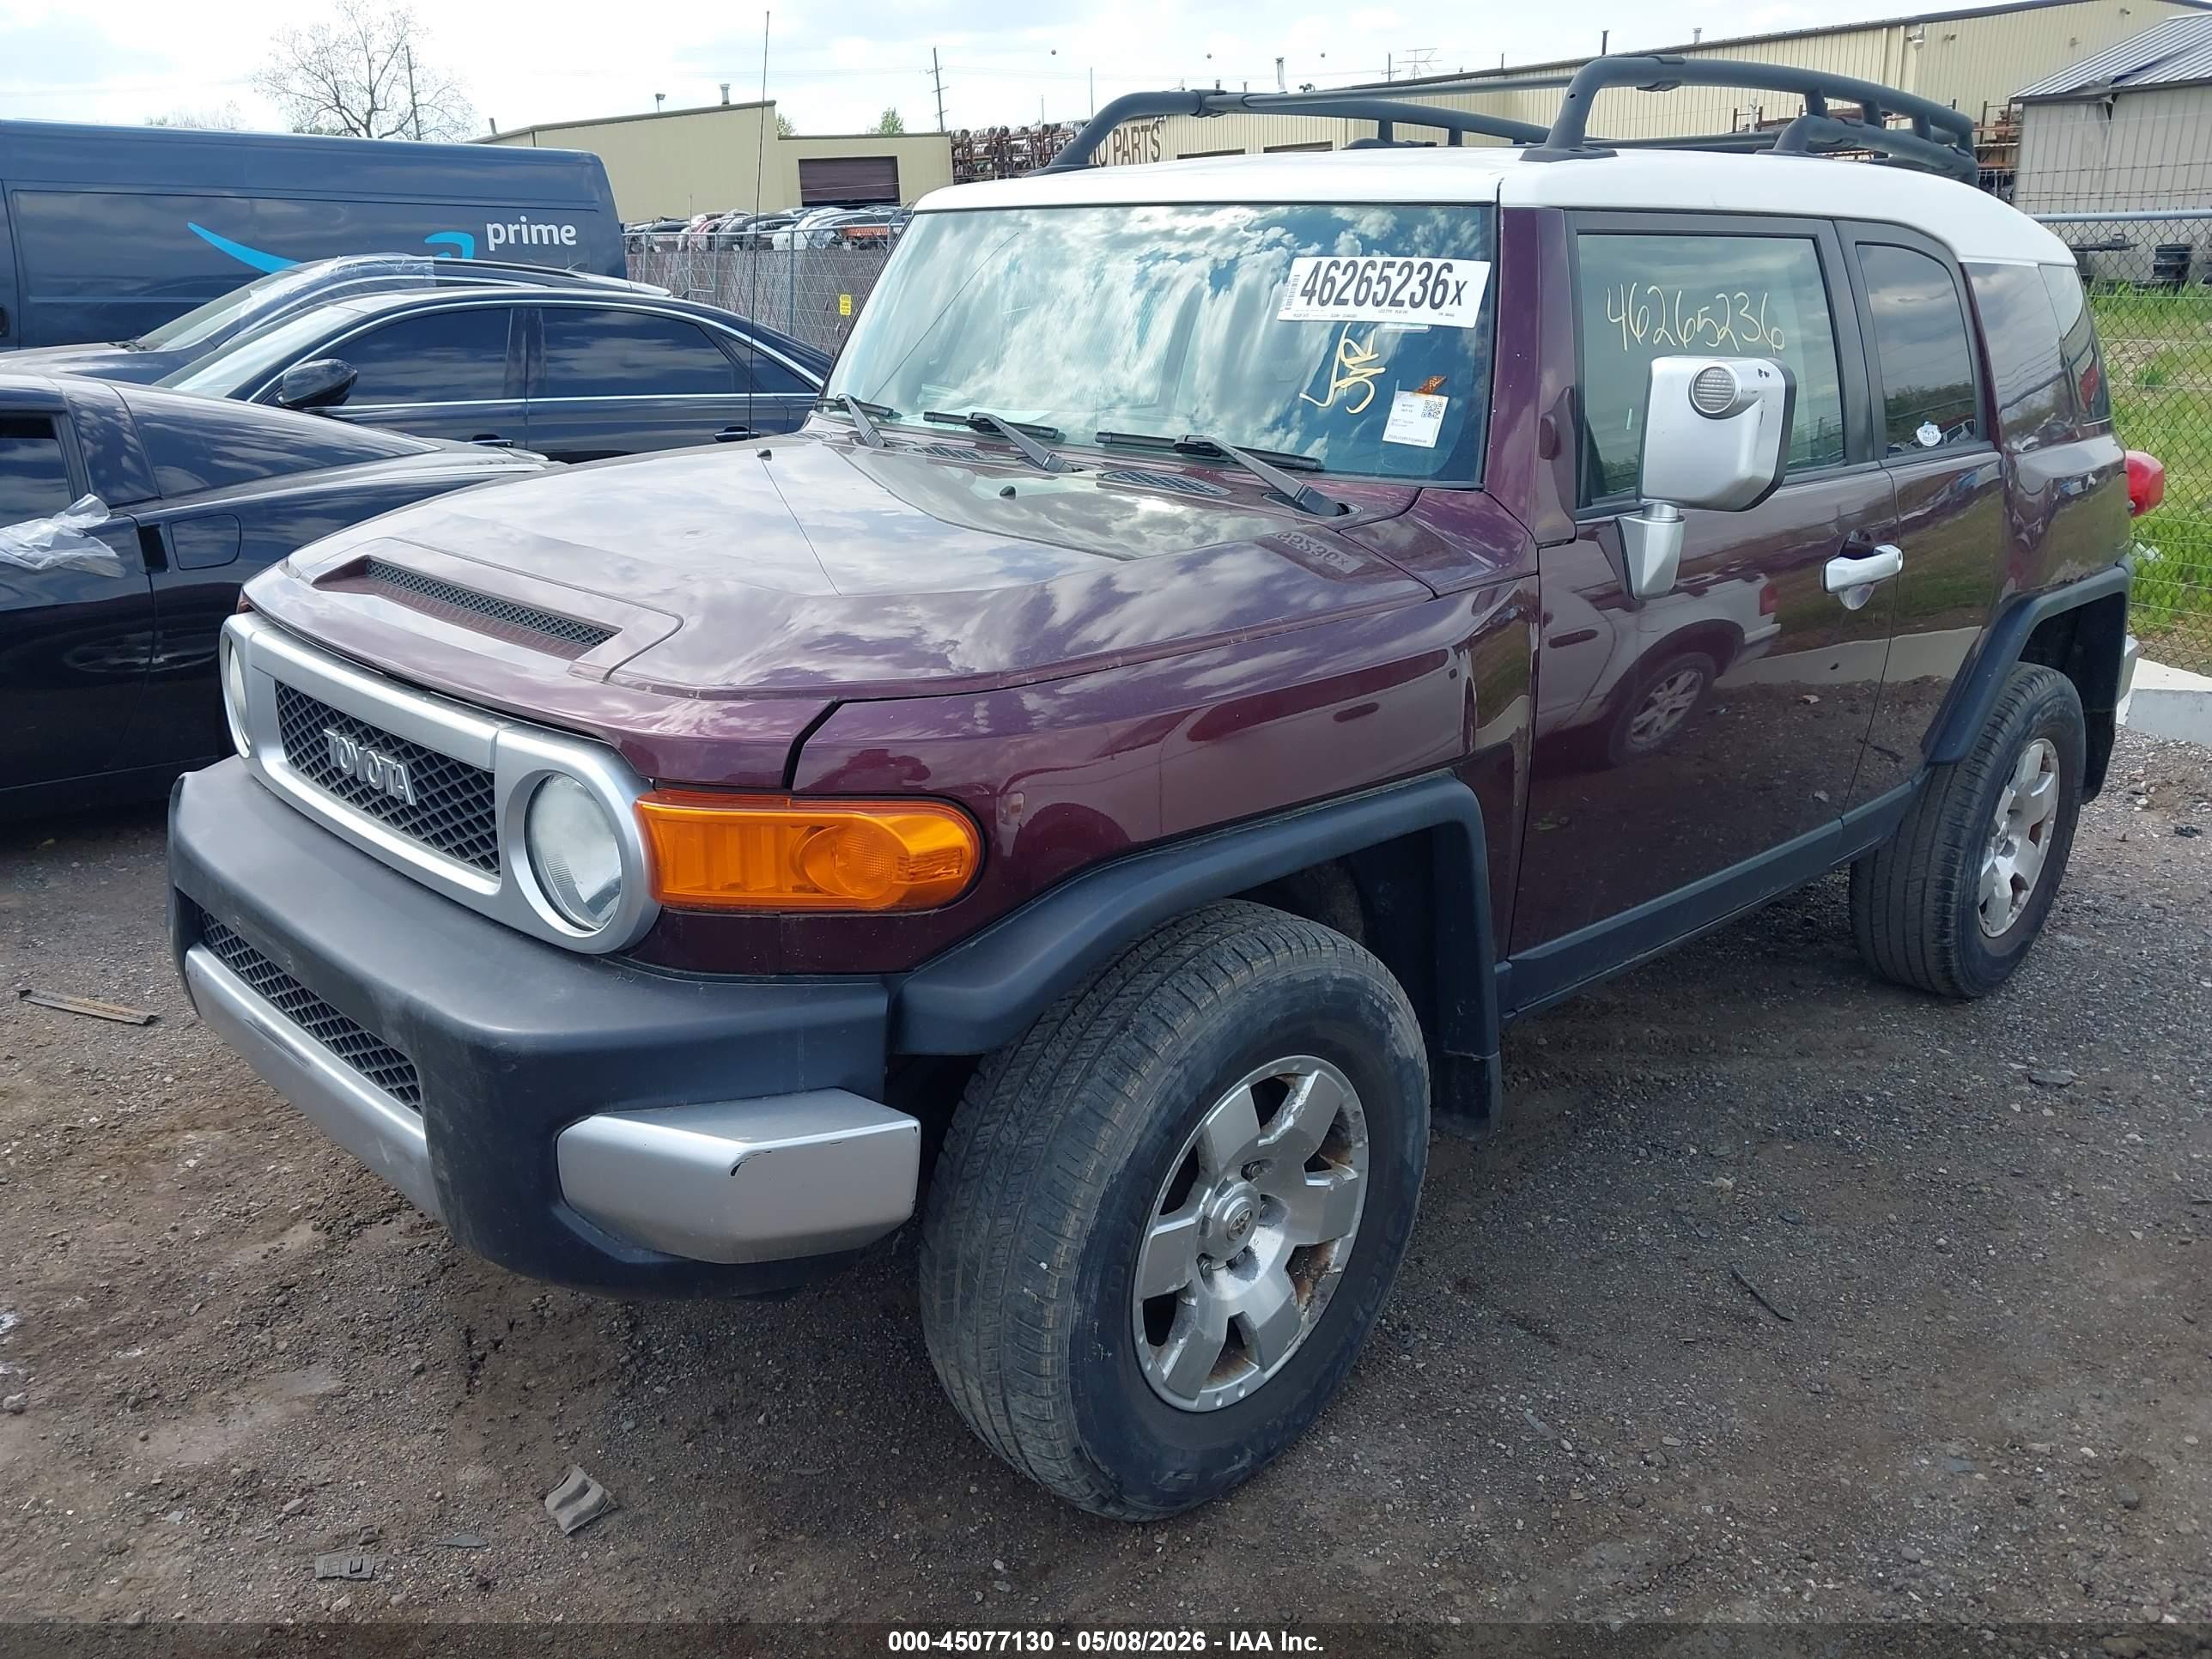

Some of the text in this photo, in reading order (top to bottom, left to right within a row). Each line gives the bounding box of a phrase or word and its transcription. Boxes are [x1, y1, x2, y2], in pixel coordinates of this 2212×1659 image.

[1113, 124, 1161, 165] PARTS
[486, 216, 576, 251] prime
[1607, 282, 1786, 355] 46265236
[323, 728, 417, 805] TOYOTA
